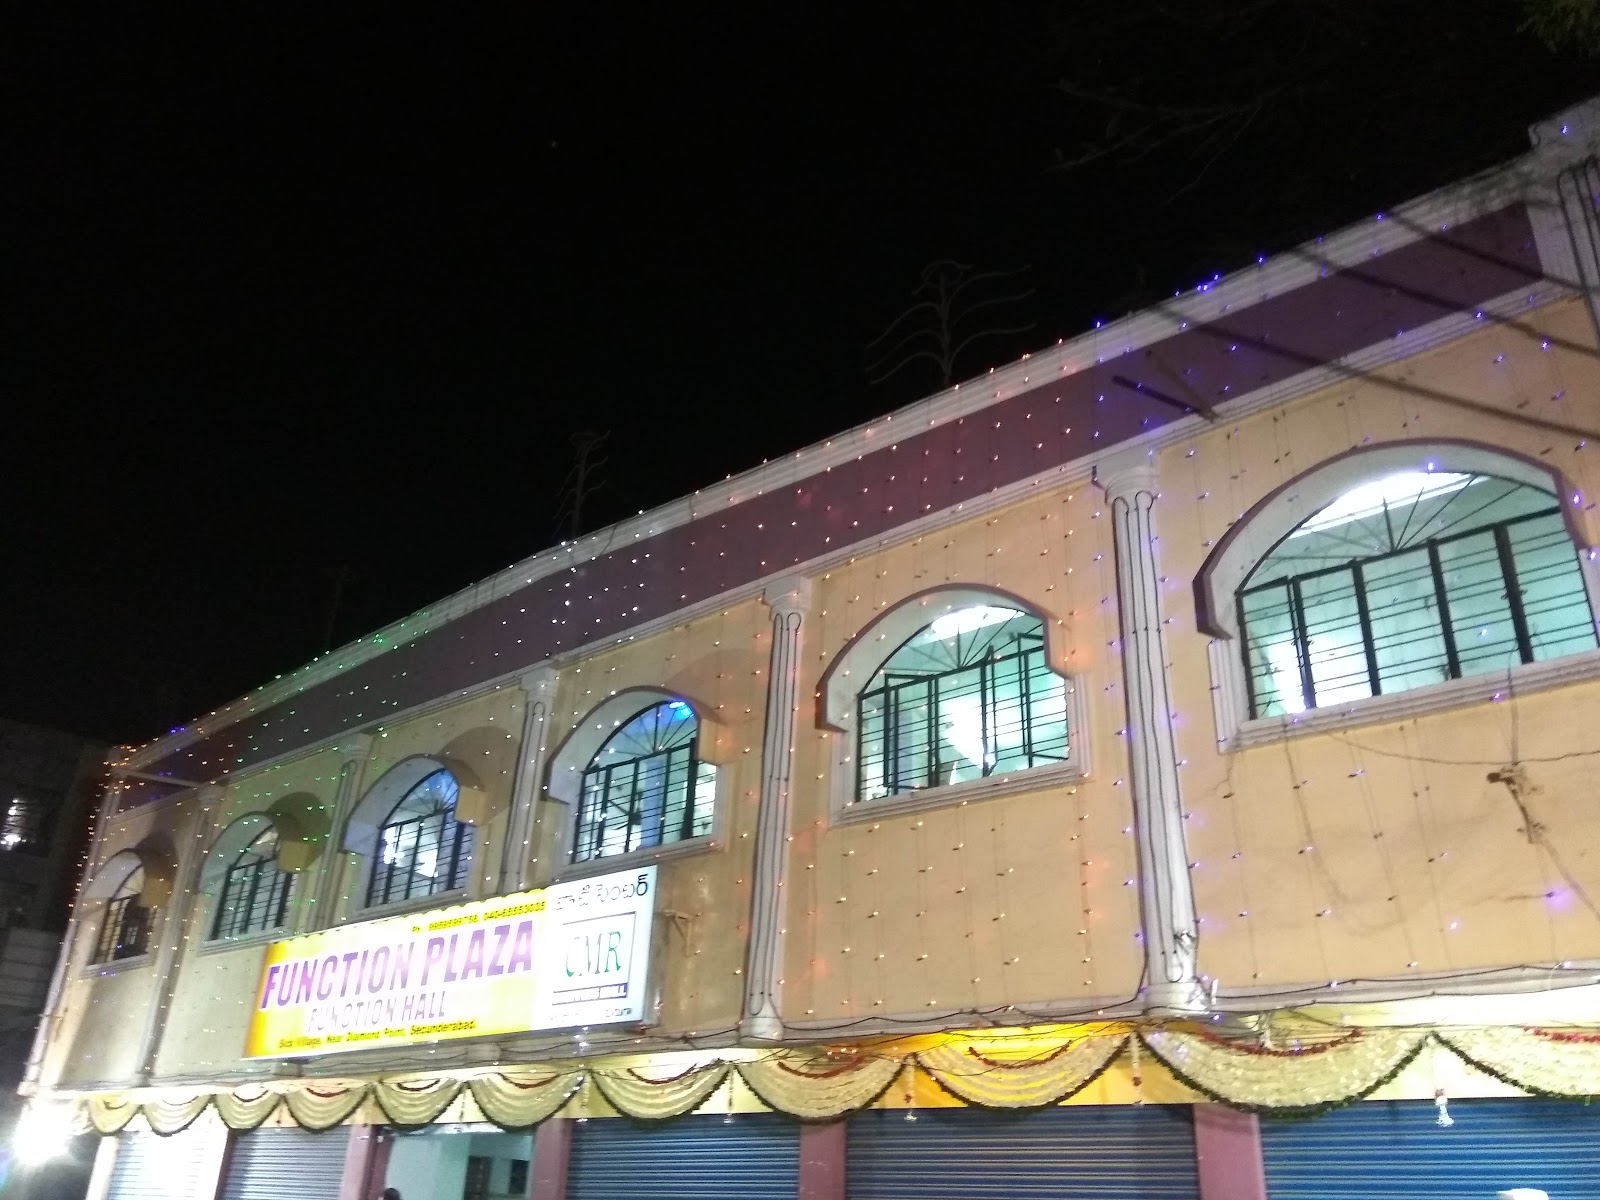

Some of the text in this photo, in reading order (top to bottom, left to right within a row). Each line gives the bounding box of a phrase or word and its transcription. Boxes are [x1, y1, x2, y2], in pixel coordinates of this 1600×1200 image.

[260, 920, 533, 1009] FUNCTION PLAZA
[566, 931, 621, 977] CMR
[308, 991, 445, 1032] FUNCTION HALL
